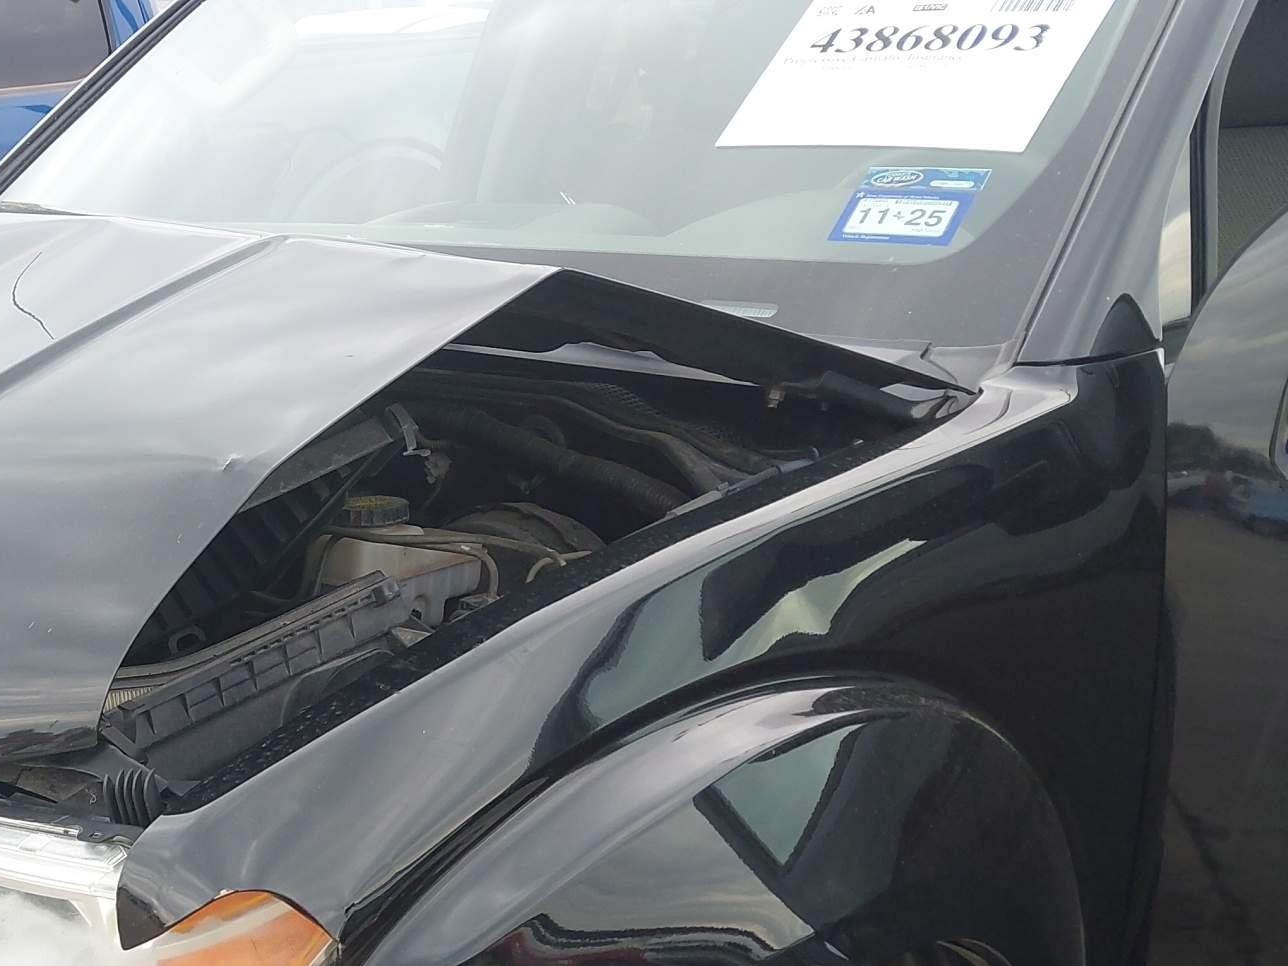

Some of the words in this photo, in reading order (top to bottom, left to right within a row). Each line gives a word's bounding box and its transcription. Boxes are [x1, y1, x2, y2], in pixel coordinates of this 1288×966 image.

[810, 24, 1050, 53] 43868093
[858, 207, 891, 225] 11
[903, 208, 946, 227] 25
